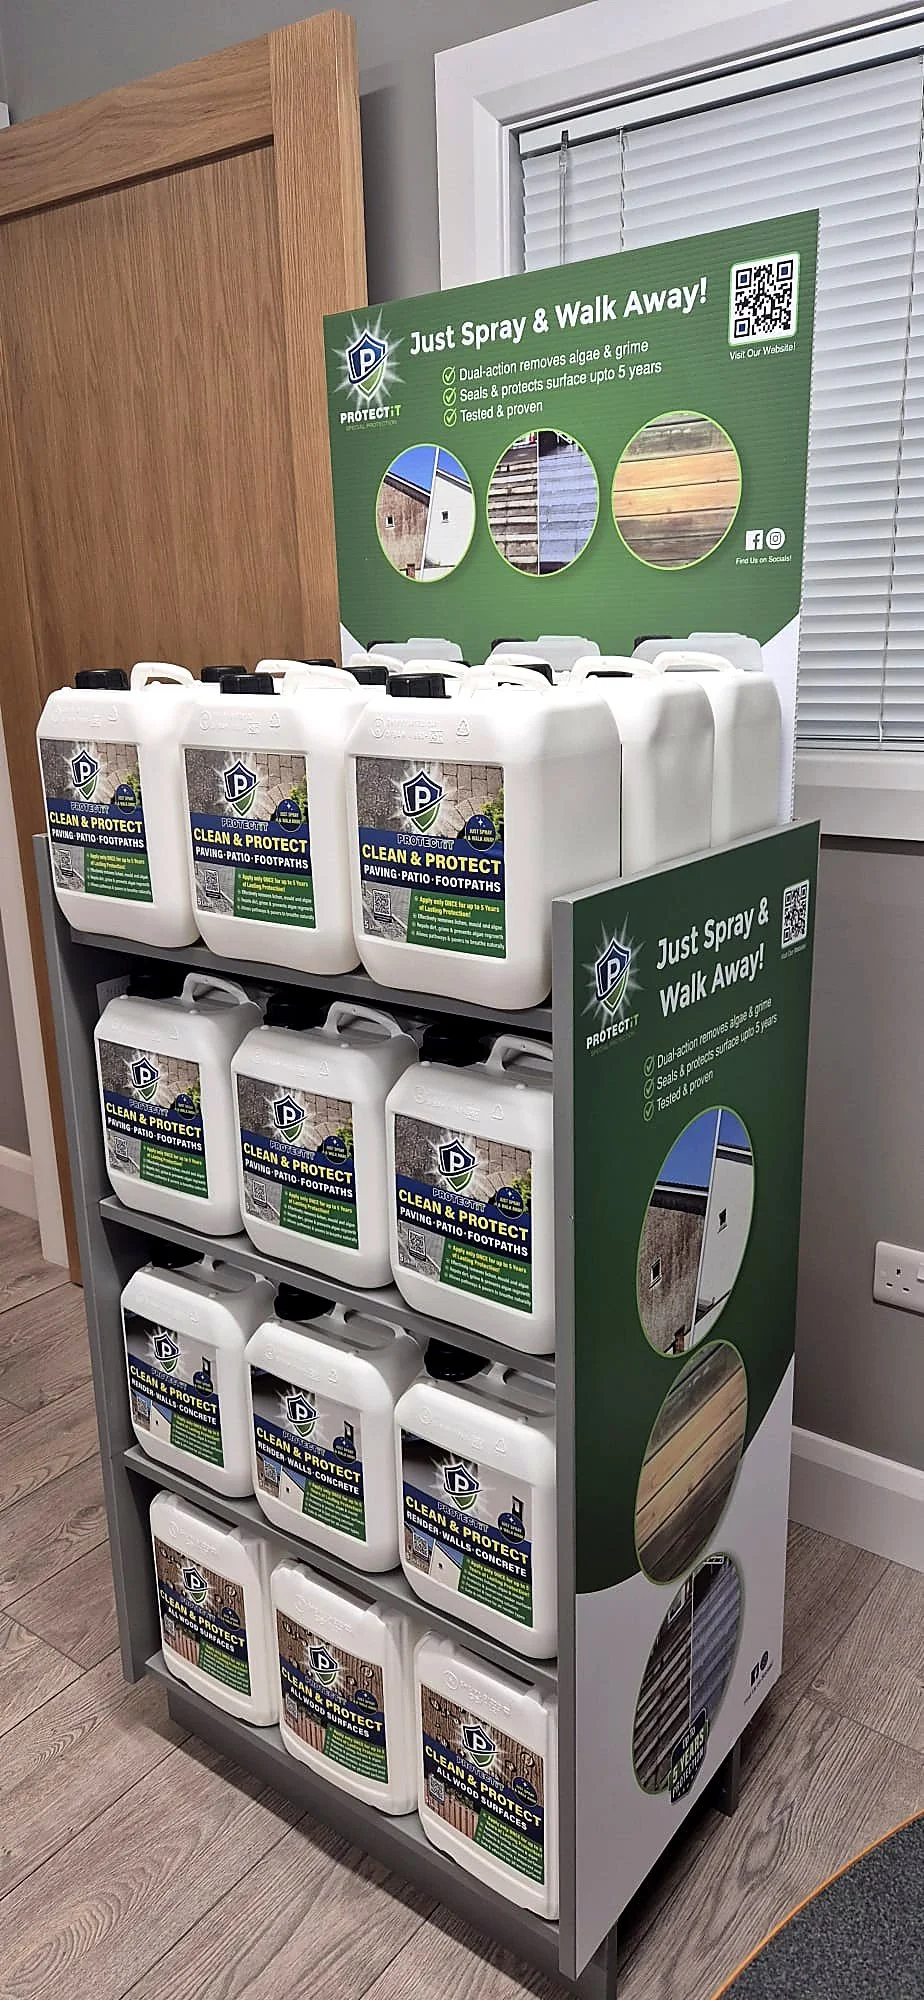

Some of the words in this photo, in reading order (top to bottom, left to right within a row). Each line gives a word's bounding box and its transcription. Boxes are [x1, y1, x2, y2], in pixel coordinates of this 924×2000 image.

[410, 326, 454, 355] Just
[461, 316, 526, 350] Spray
[532, 308, 549, 333] &
[555, 296, 616, 328] Walk
[623, 277, 707, 318] Away!
[459, 360, 517, 381] Dual-action
[520, 354, 566, 372] removes
[570, 347, 600, 364] algae
[603, 344, 612, 358] &
[616, 340, 648, 359] grime
[730, 351, 745, 360] Visit
[747, 349, 761, 357] Our
[763, 342, 796, 355] Website!
[460, 384, 488, 402] Seals
[491, 384, 498, 397] &
[502, 376, 544, 397] protects
[546, 373, 586, 390] surface
[590, 368, 615, 385] upto
[618, 365, 626, 378] 5
[628, 361, 662, 381] years
[460, 406, 494, 422] Tested
[496, 406, 504, 417] &
[507, 402, 542, 420] proven
[50, 812, 79, 826] CLEAN
[81, 816, 88, 827] &
[91, 817, 142, 833] PROTECT
[194, 829, 231, 845] CLEAN
[234, 833, 242, 846] &
[246, 836, 307, 853] PROTECT
[362, 844, 406, 864] CLEAN
[410, 851, 422, 866] &
[426, 856, 501, 875] PROTECT
[657, 927, 699, 970] Just
[704, 908, 754, 951] Spray
[758, 897, 769, 925] &
[660, 970, 707, 1017] Walk
[711, 943, 765, 994] Away!
[657, 1039, 698, 1068] Dual-action
[700, 1021, 728, 1045] removes
[730, 1011, 748, 1031] algae
[749, 1008, 754, 1019] &
[754, 998, 772, 1018] grime
[657, 1070, 678, 1090] Seals
[679, 1065, 685, 1075] &
[686, 1049, 714, 1075] protects
[715, 1034, 739, 1056] surface
[740, 1027, 754, 1046] upto
[755, 1024, 760, 1033] 5
[760, 1014, 778, 1033] years
[657, 1090, 681, 1111] Tested
[683, 1085, 688, 1095] &
[690, 1070, 714, 1094] proven
[106, 1102, 137, 1122] CLEAN
[139, 1113, 147, 1125] &
[149, 1116, 201, 1138] PROTECT
[244, 1143, 278, 1165] CLEAN
[281, 1155, 289, 1168] &
[293, 1160, 352, 1184] PROTECT
[399, 1189, 441, 1215] CLEAN
[445, 1205, 455, 1220] &
[459, 1211, 528, 1241] PROTECT
[130, 1365, 158, 1391] CLEAN
[160, 1382, 168, 1393] &
[170, 1386, 217, 1414] PROTECT
[257, 1426, 290, 1454] CLEAN
[293, 1445, 301, 1457] &
[304, 1451, 360, 1483] PROTECT
[406, 1496, 447, 1527] CLEAN
[449, 1520, 459, 1534] &
[463, 1526, 528, 1565] PROTECT
[160, 1589, 187, 1617] CLEAN
[189, 1611, 196, 1623] &
[199, 1616, 245, 1648] PROTECT
[168, 1607, 179, 1621] ALL
[180, 1615, 198, 1632] WOOD
[200, 1627, 234, 1653] SURFACES
[281, 1666, 312, 1699] CLEAN
[314, 1692, 323, 1705] &
[326, 1699, 382, 1732] PROTECT
[290, 1687, 302, 1701] ALL
[303, 1697, 325, 1716] WOOD
[327, 1710, 369, 1738] SURFACES
[425, 1745, 464, 1780] CLEAN
[467, 1774, 477, 1788] &
[481, 1781, 542, 1827] PROTECT
[436, 1766, 452, 1783] ALL
[452, 1776, 479, 1800] WOOD
[481, 1795, 528, 1831] SURFACES
